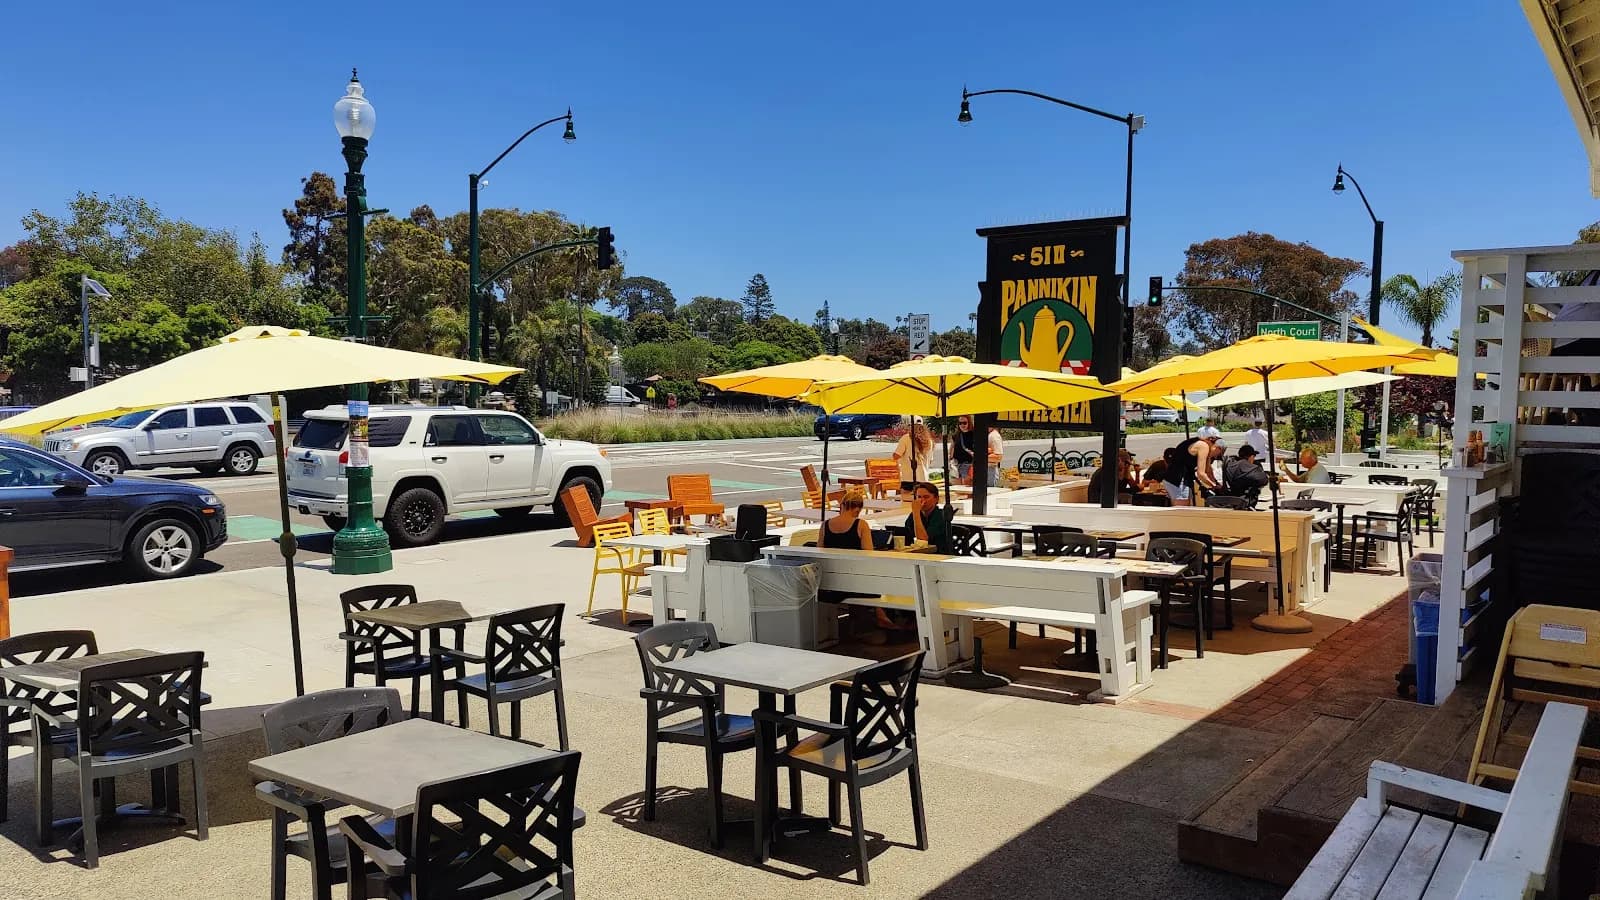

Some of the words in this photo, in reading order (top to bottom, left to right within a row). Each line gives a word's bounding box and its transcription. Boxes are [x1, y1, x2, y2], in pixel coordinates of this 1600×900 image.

[1030, 244, 1066, 266] 510
[1001, 275, 1098, 335] PANNIKIN
[1260, 328, 1286, 336] North
[1289, 328, 1316, 336] Court
